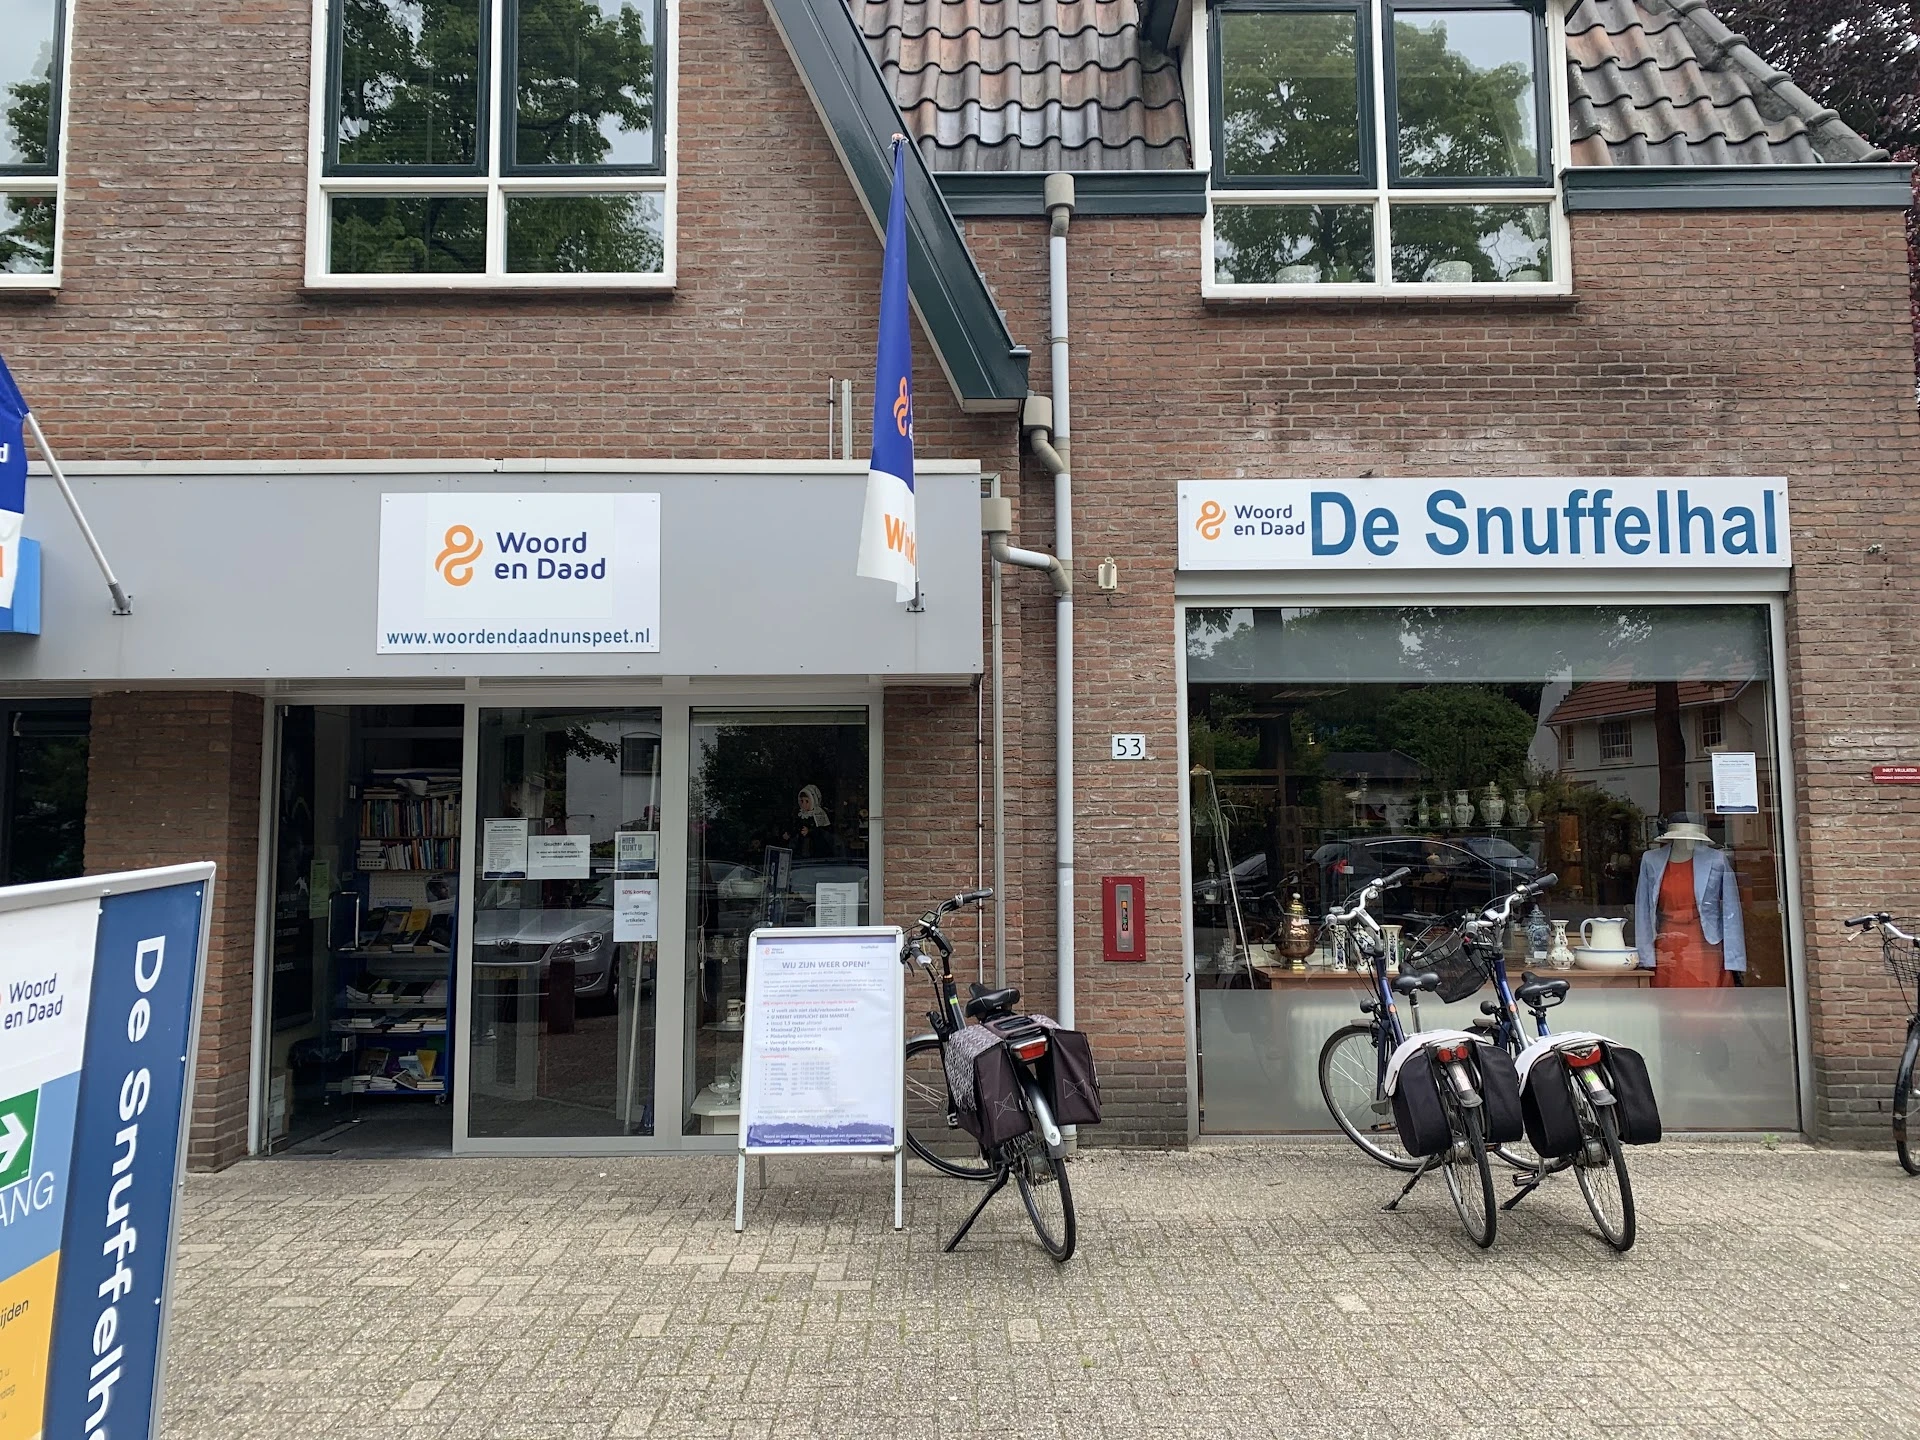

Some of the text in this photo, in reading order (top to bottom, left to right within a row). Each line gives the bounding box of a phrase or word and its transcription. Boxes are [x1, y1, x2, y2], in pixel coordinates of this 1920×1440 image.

[1233, 504, 1293, 519] Woord
[1310, 488, 1777, 557] De Snuffelhal
[1233, 520, 1306, 537] en Daad
[496, 531, 588, 554] Woord
[494, 557, 606, 580] en Daad
[386, 627, 651, 648] www.woordendaadnunspeet.nl
[1116, 738, 1141, 756] 53
[633, 889, 651, 897] korting
[782, 961, 797, 969] WIJ
[798, 961, 816, 969] ZIJN
[818, 960, 840, 968] WEER
[9, 972, 57, 1004] Woord
[4, 994, 64, 1030] en Daad
[84, 935, 166, 1440] De Snuffelh
